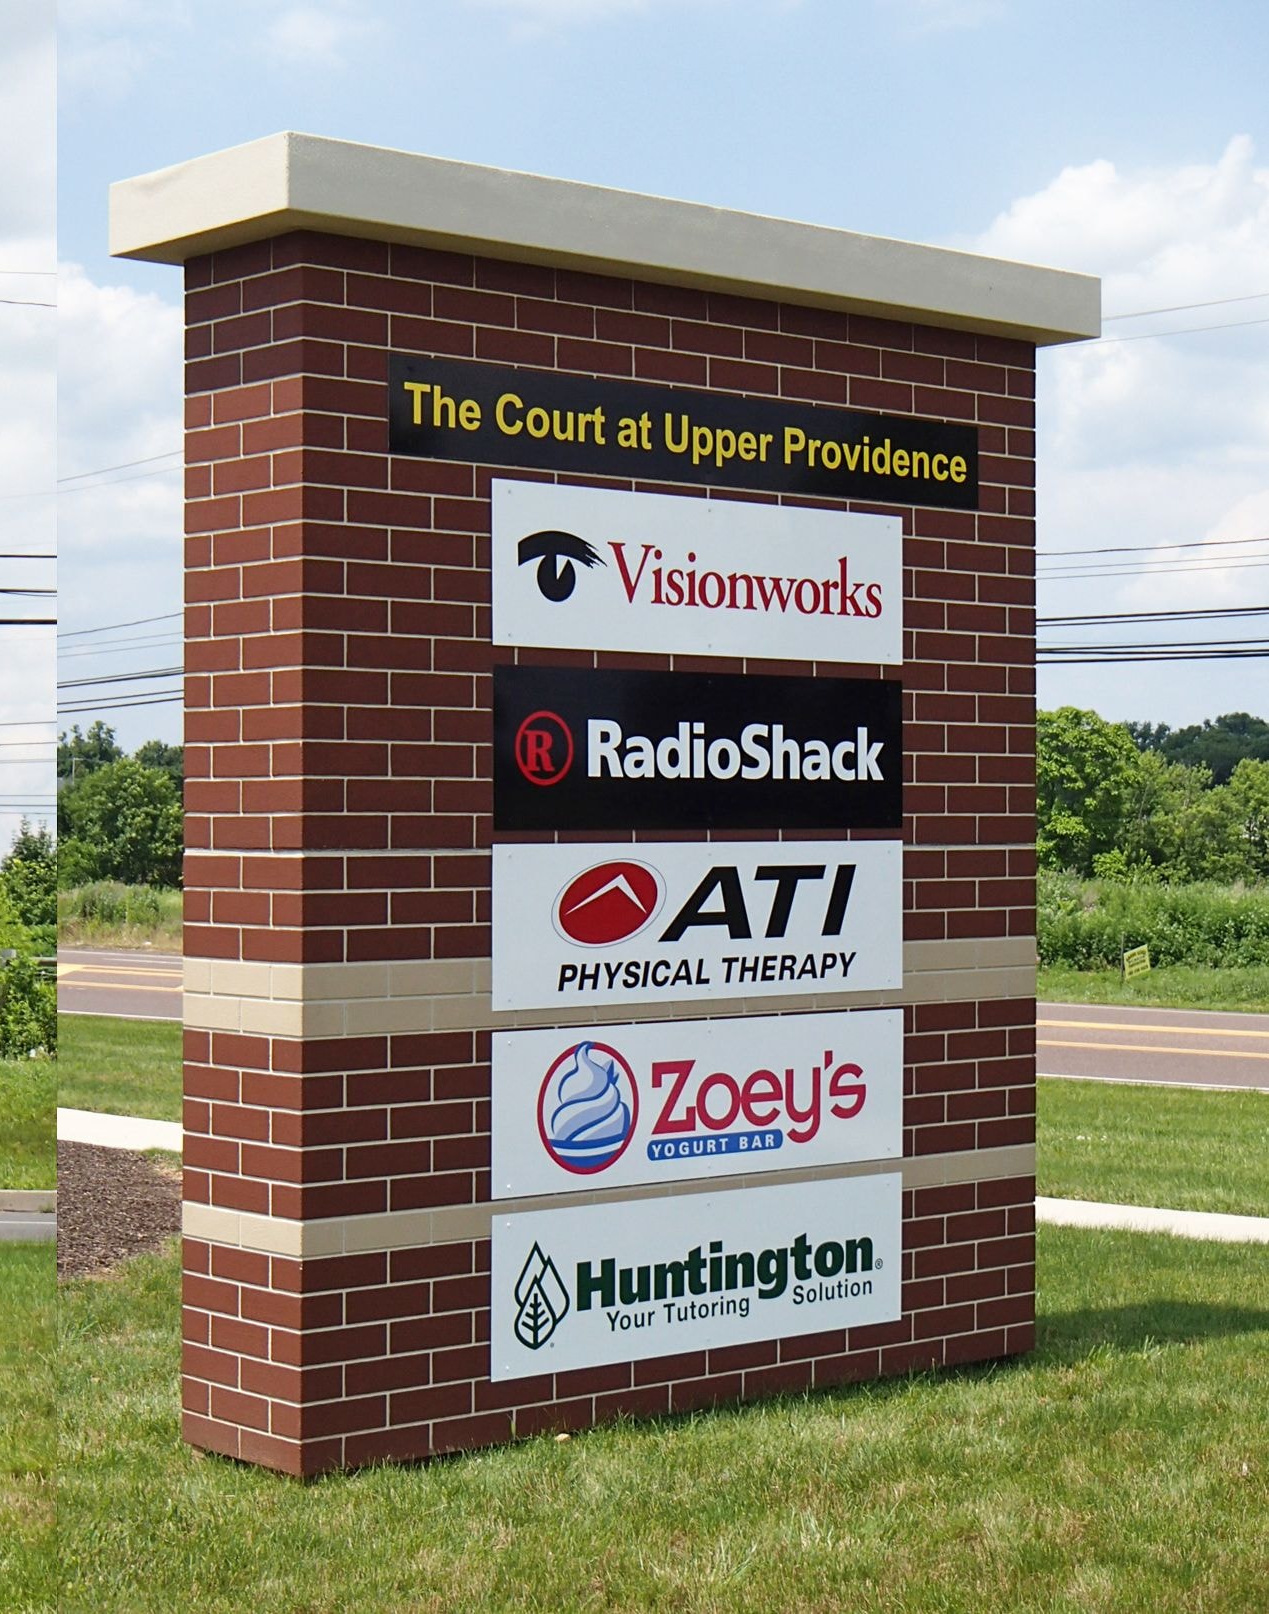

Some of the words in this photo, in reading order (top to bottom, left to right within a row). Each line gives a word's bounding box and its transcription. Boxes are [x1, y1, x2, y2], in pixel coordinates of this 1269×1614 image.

[404, 383, 481, 430] The
[496, 394, 605, 444] Court
[618, 415, 651, 449] at
[666, 415, 772, 466] Upper
[785, 428, 966, 482] Providence
[607, 541, 882, 619] Visionworks
[588, 720, 883, 780] RadioShack
[657, 864, 857, 942] ATI
[558, 959, 710, 991] PHYSICAL
[722, 952, 856, 983] THERAPY
[651, 1050, 867, 1144] Zoey's
[651, 1137, 729, 1159] YOGURT
[739, 1133, 776, 1150] BAR
[606, 1308, 655, 1332] Your
[663, 1297, 750, 1325] Tutoring
[792, 1278, 873, 1305] Solution
